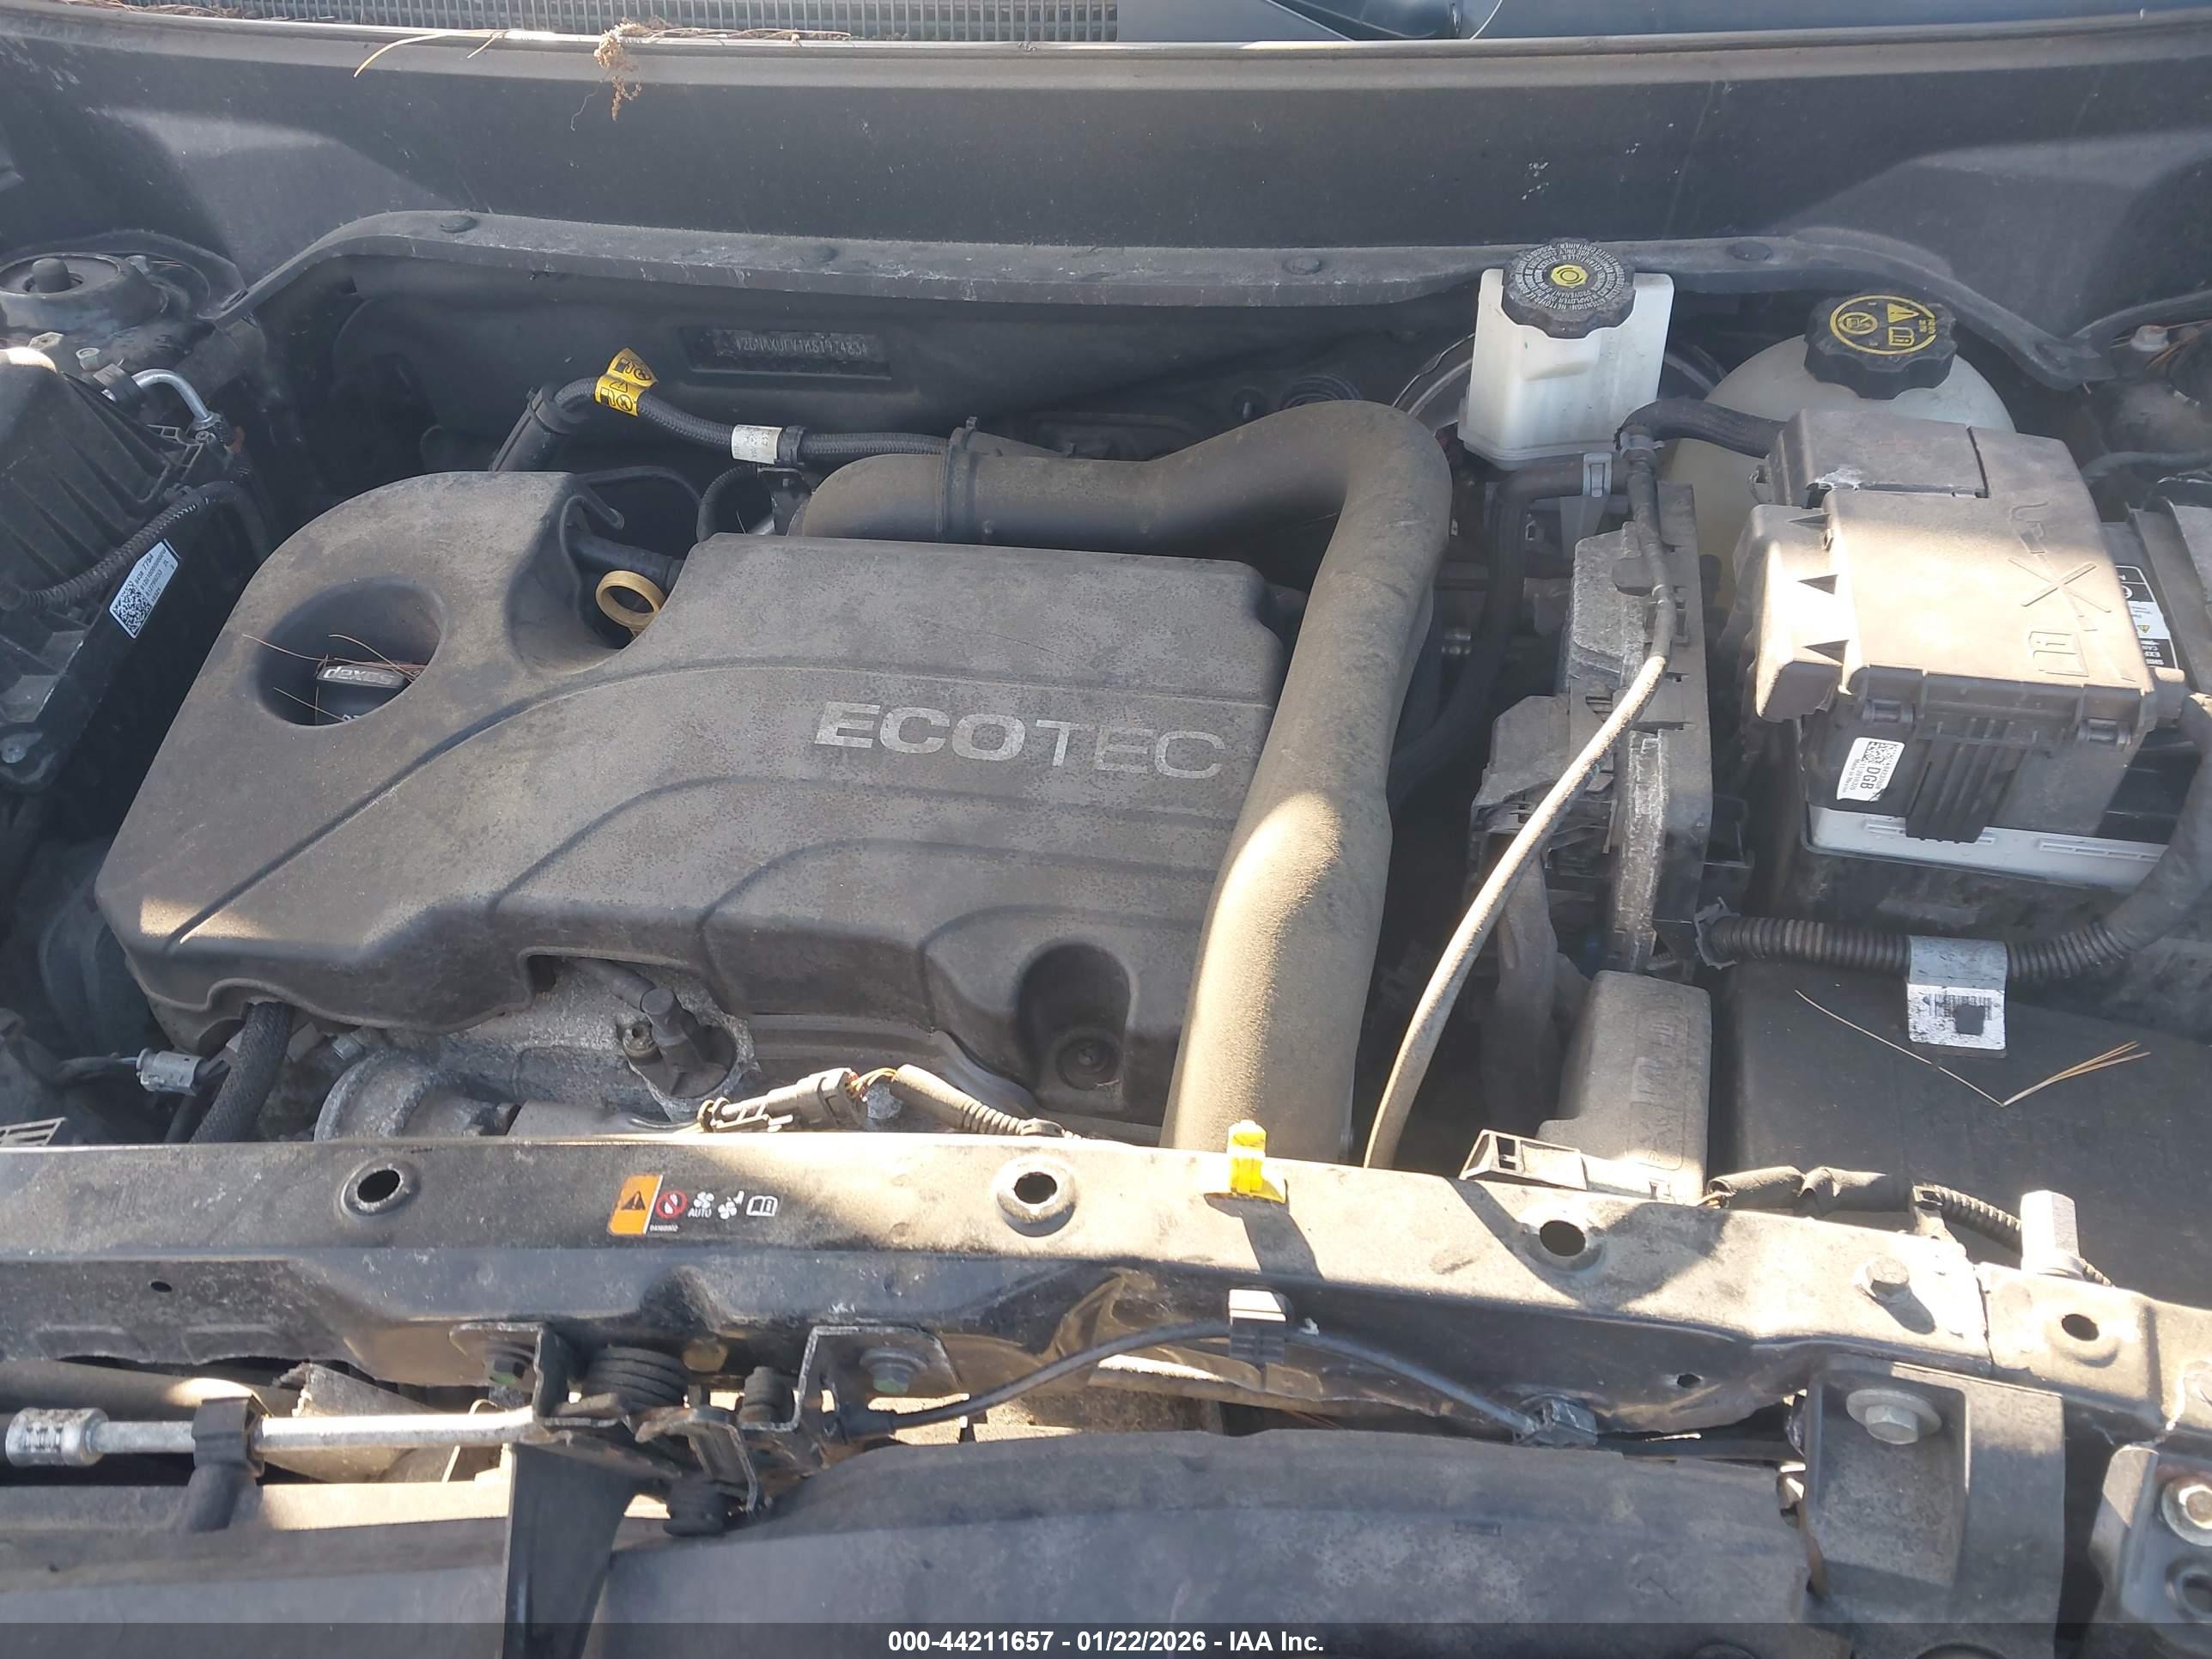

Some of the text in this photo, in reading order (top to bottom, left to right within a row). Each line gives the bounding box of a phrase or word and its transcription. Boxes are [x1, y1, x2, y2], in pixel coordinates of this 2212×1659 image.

[323, 665, 394, 685] dexos
[814, 701, 1226, 779] ECOTEC
[1861, 767, 1881, 789] DGB
[687, 1207, 712, 1218] AUTO
